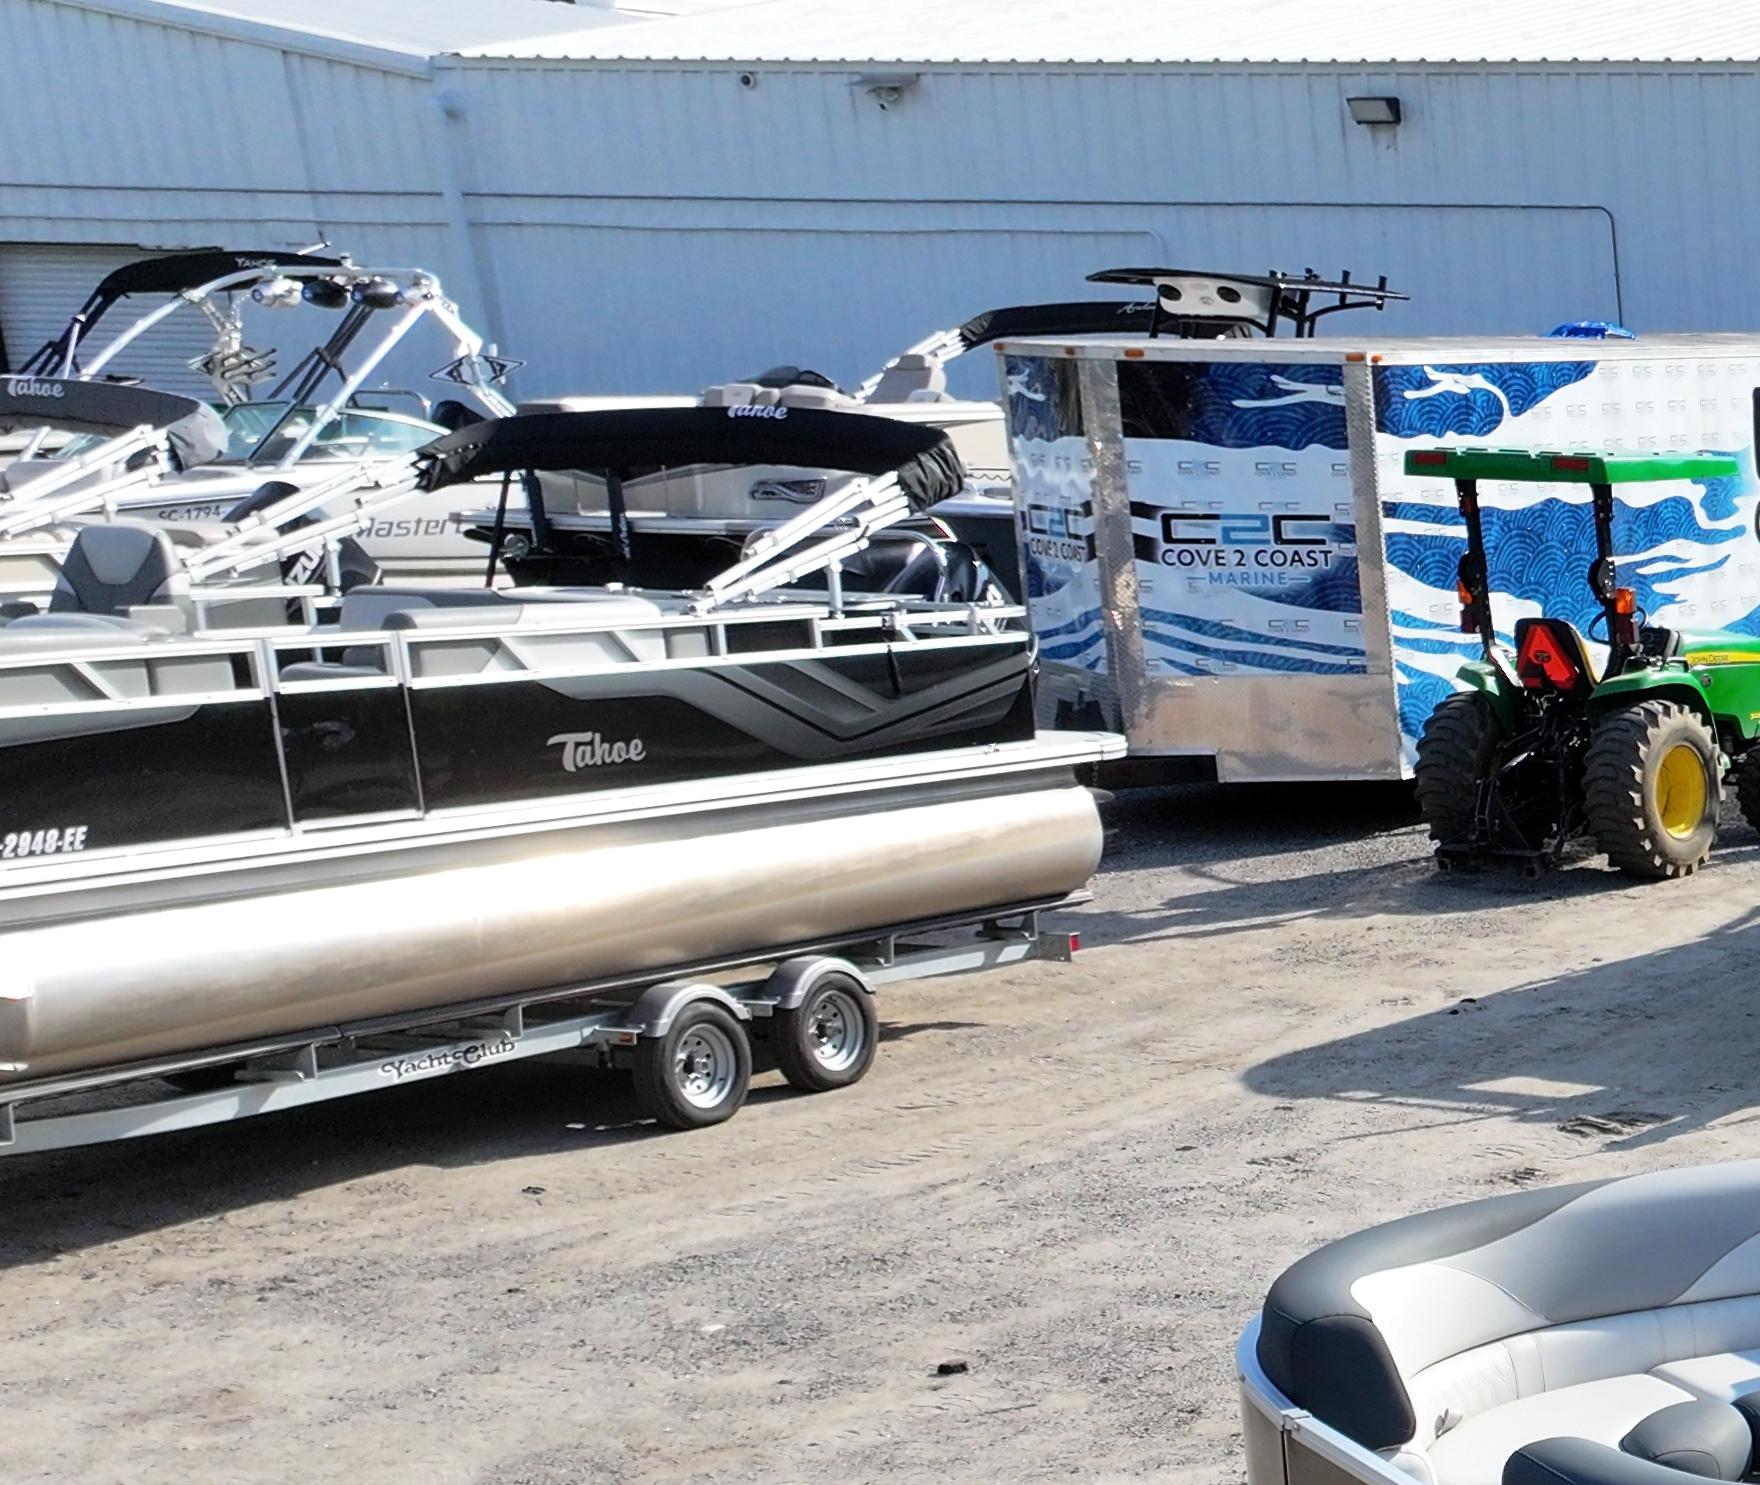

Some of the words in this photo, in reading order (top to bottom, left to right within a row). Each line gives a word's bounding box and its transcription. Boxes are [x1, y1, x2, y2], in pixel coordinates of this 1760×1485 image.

[1160, 512, 1331, 546] C2C
[1161, 548, 1227, 567] COVE
[1234, 549, 1247, 567] 2
[1254, 549, 1333, 568] COAST
[1208, 571, 1289, 585] MARINE
[546, 731, 647, 772] Tahoe
[380, 1051, 453, 1080] Yacht
[452, 1029, 516, 1065] Club
